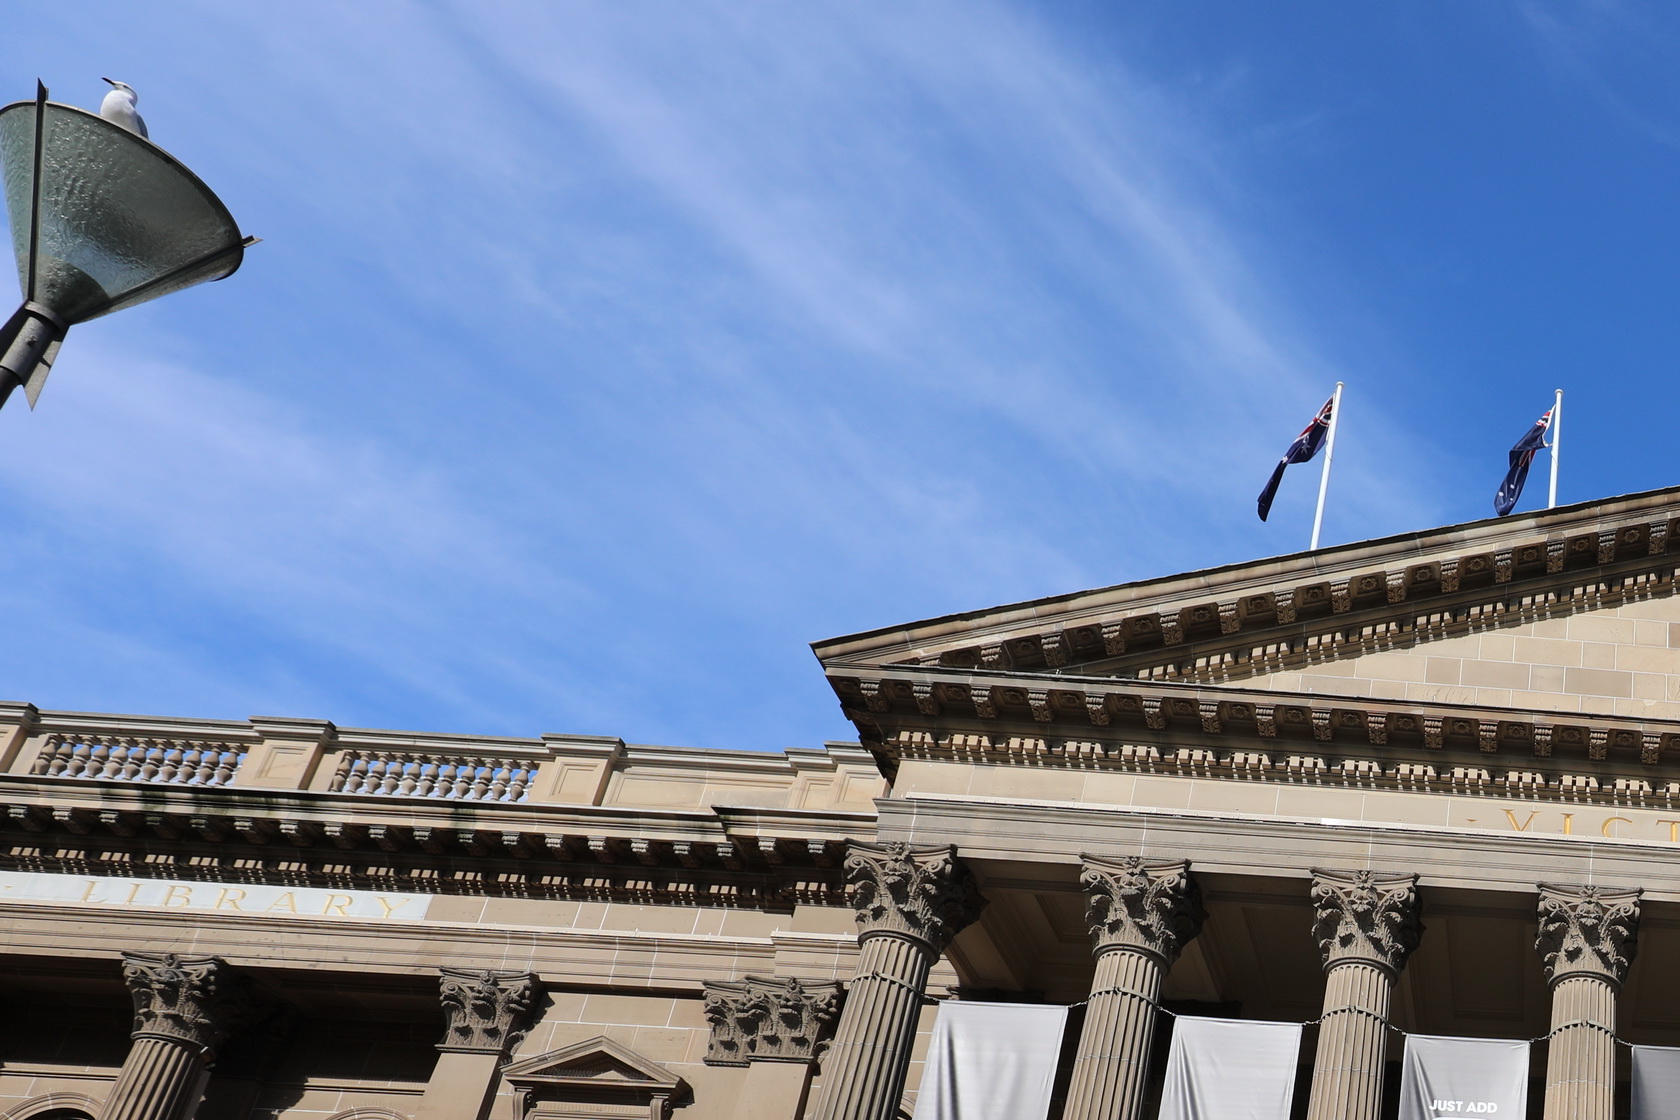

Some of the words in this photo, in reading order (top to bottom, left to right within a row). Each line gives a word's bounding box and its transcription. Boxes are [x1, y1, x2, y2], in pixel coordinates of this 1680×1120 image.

[81, 880, 411, 919] LIBRARY
[1429, 1099, 1463, 1113] JUST
[1466, 1100, 1498, 1114] ADD
